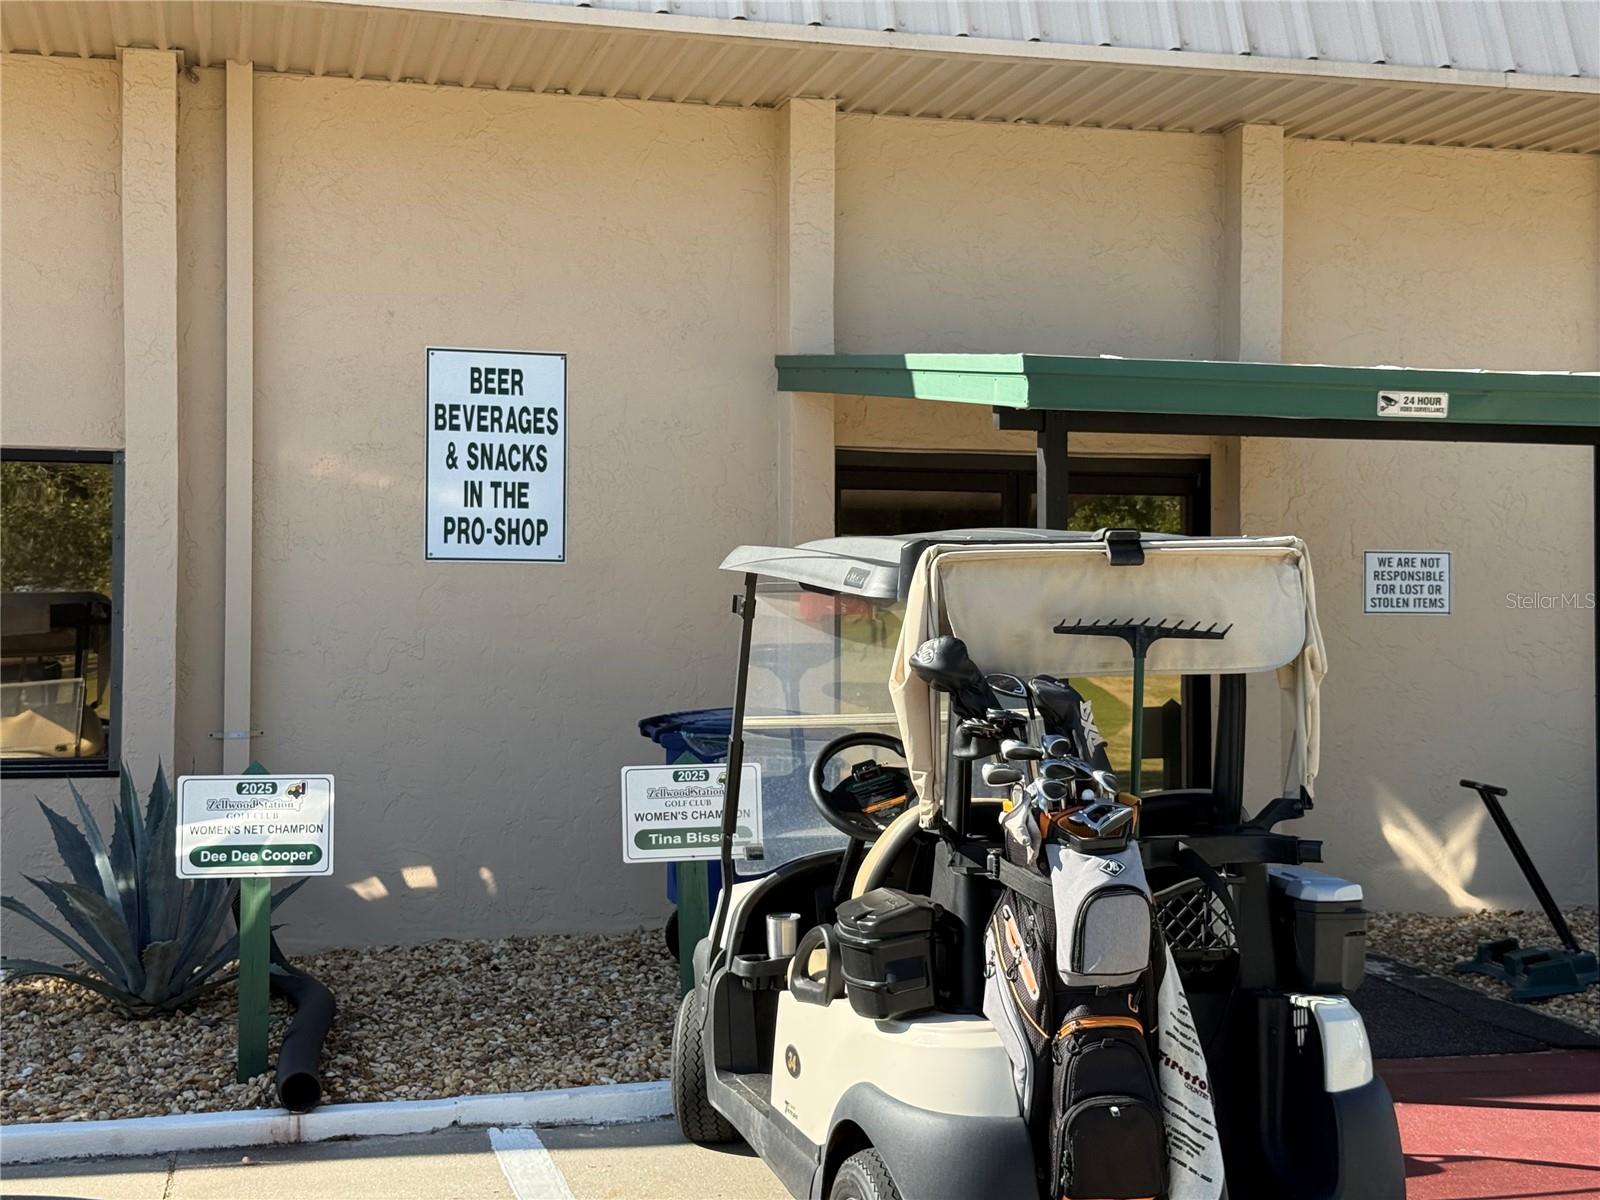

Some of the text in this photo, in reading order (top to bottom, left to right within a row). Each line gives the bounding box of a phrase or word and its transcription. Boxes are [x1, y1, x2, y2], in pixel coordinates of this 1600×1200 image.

[470, 367, 524, 396] BEER
[1404, 396, 1442, 406] 24 HOUR
[434, 404, 558, 435] BEVERAGES
[446, 442, 548, 472] & SNACKS
[464, 480, 529, 509] IN THE
[444, 516, 548, 546] PRO-SHOP
[1377, 557, 1440, 568] WE ARE NOT
[1373, 570, 1444, 581] RESPONSIBLE
[1376, 584, 1442, 595] FOR LOST OR
[1370, 597, 1445, 608] STOLEN ITEMS
[678, 770, 706, 781] 2025
[241, 783, 273, 794] 2025
[208, 800, 256, 809] Zellwood
[634, 811, 688, 822] WOMEN'S
[190, 824, 324, 835] WOMEN'S NET CHAMPION
[648, 833, 681, 844] Tina
[200, 849, 312, 863] Dee Dee Cooper
